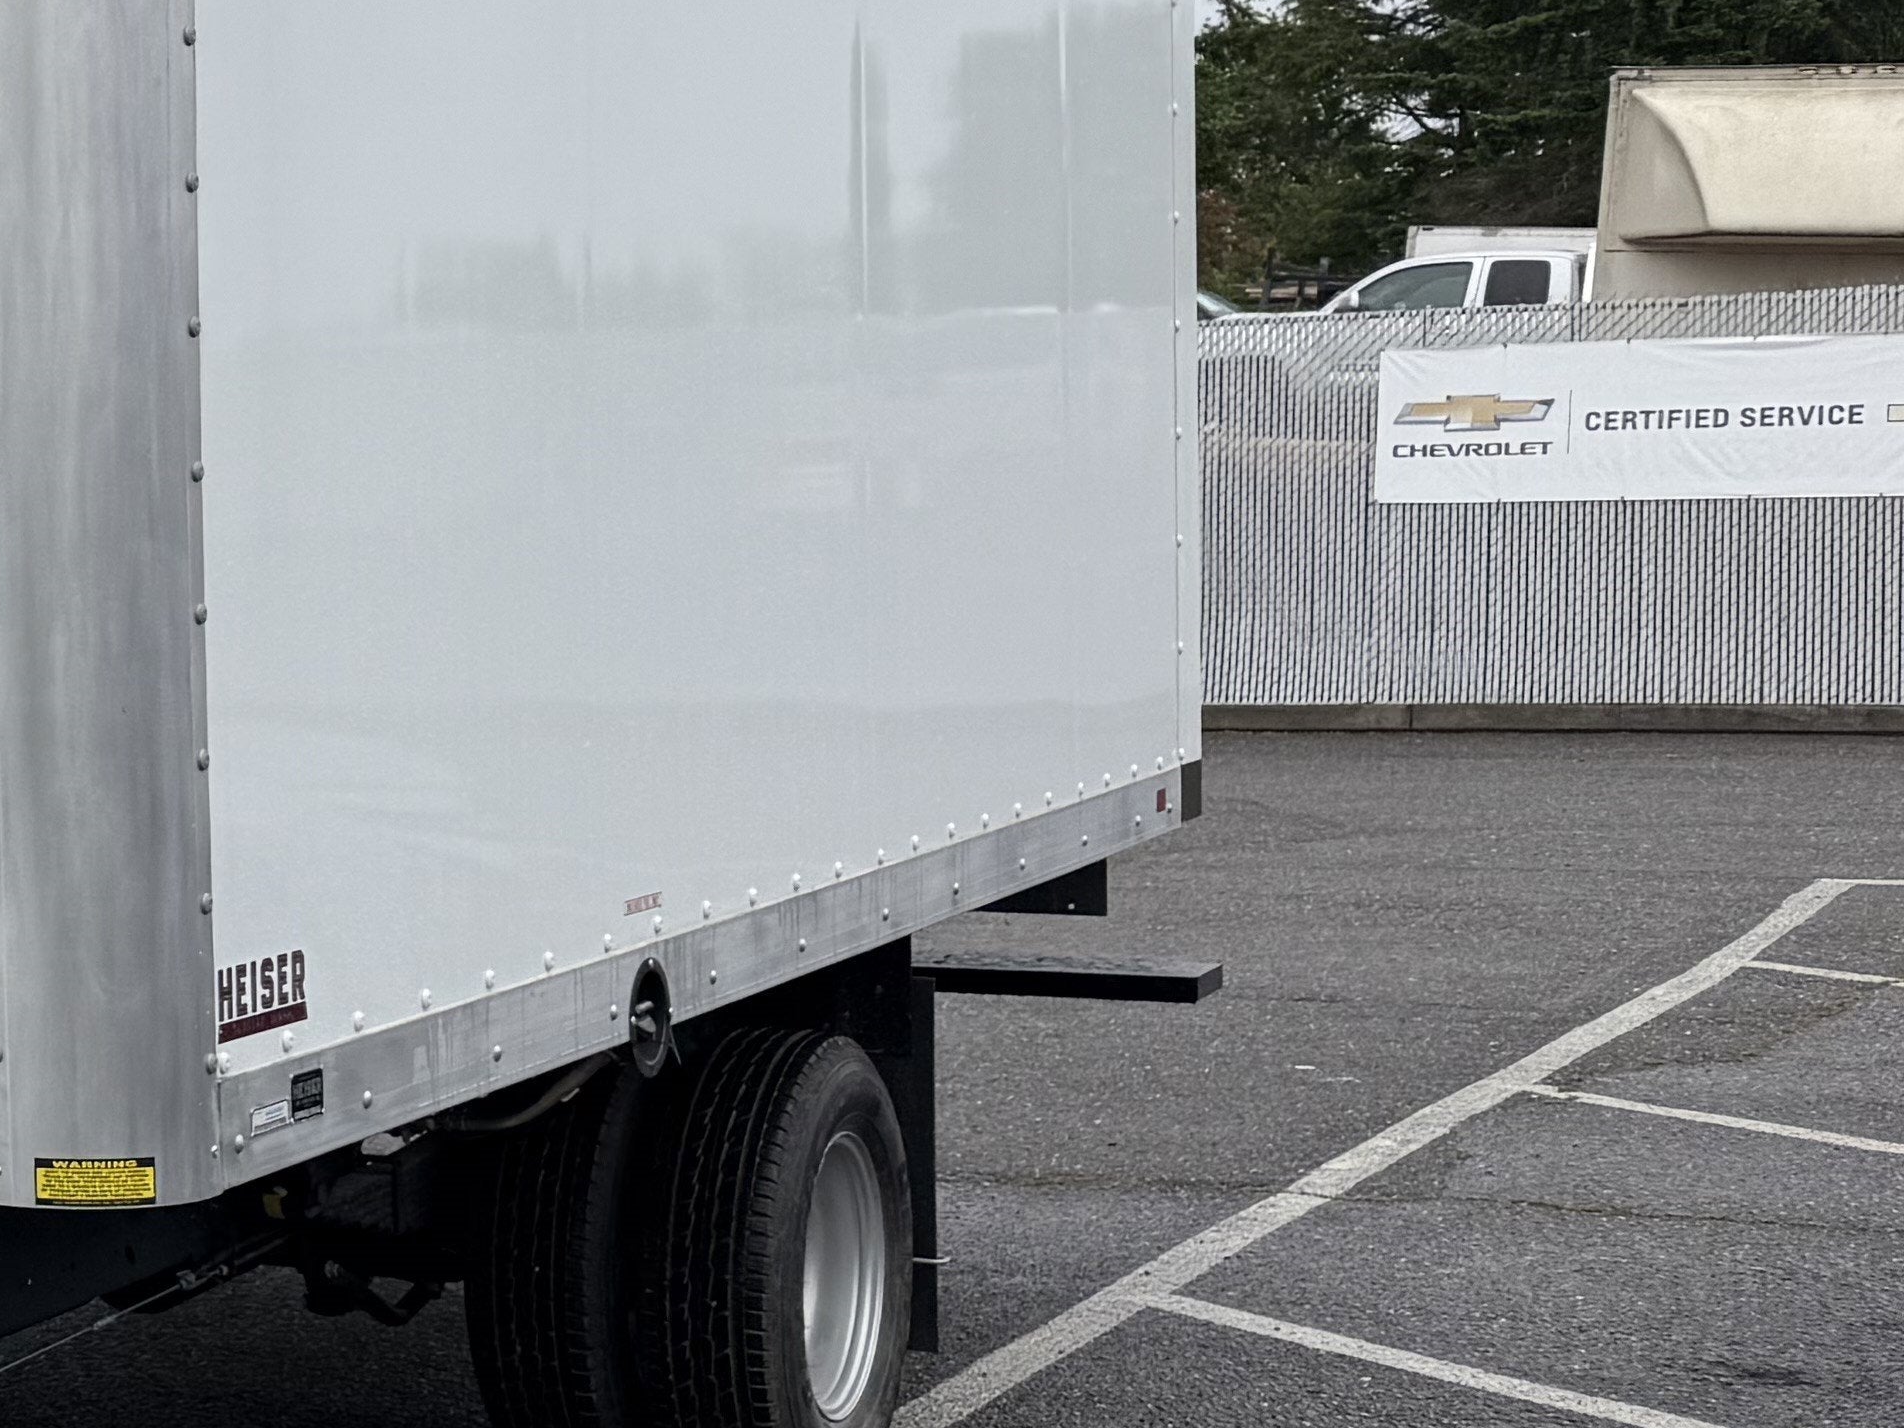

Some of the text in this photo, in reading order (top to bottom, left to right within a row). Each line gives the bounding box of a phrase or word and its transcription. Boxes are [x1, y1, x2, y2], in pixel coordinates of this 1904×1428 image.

[1585, 404, 1865, 431] CERTIFIED SERVICE
[1392, 441, 1554, 458] CHEVROLET
[217, 949, 306, 1022] HEISER
[52, 1160, 138, 1168] WARNING
